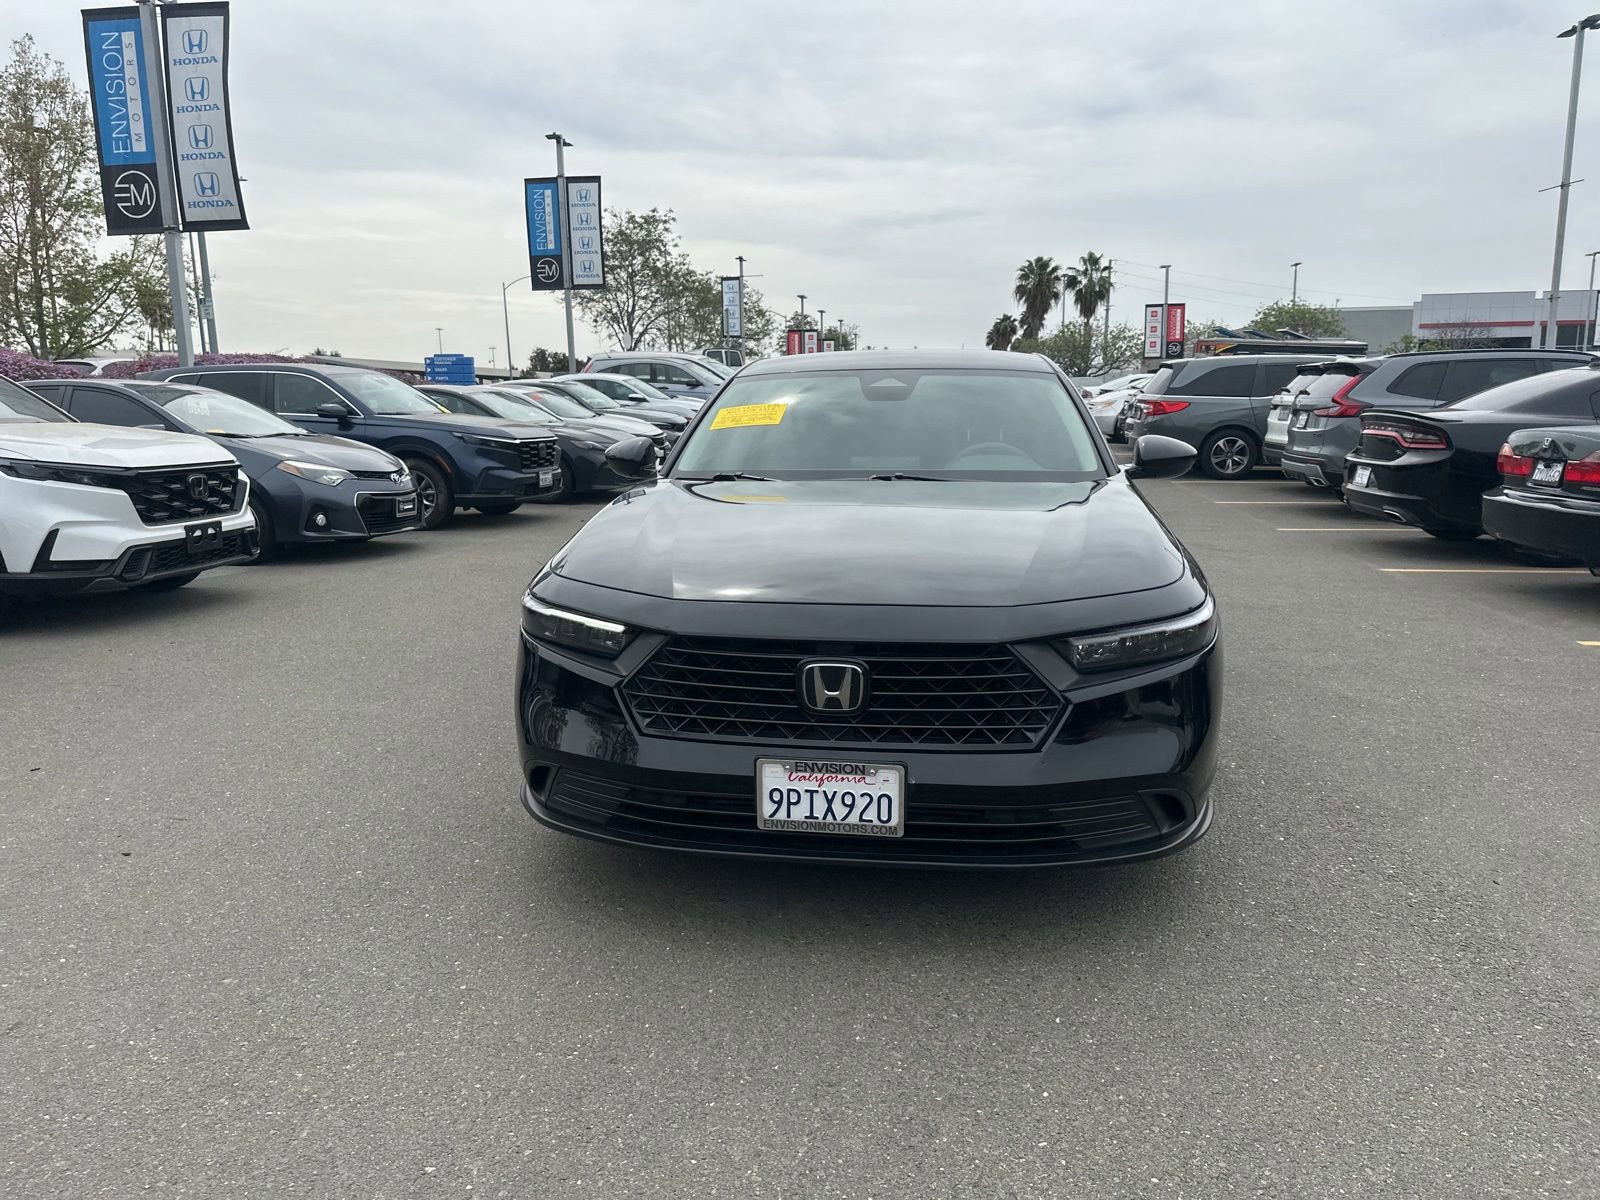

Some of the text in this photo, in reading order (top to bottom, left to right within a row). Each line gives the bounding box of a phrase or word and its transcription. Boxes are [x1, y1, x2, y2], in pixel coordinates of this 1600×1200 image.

[173, 55, 218, 66] HONDA
[101, 31, 131, 154] ENVISION
[125, 42, 142, 142] MOTORS
[176, 103, 220, 114] HONDA
[181, 151, 226, 161] HONDA
[187, 199, 234, 209] HONDA
[533, 189, 547, 250] ENVISION
[794, 761, 866, 775] ENVISION
[788, 771, 876, 788] California
[768, 787, 893, 825] 9PIX920
[763, 819, 898, 836] ENVISIONMOTORS.COM
